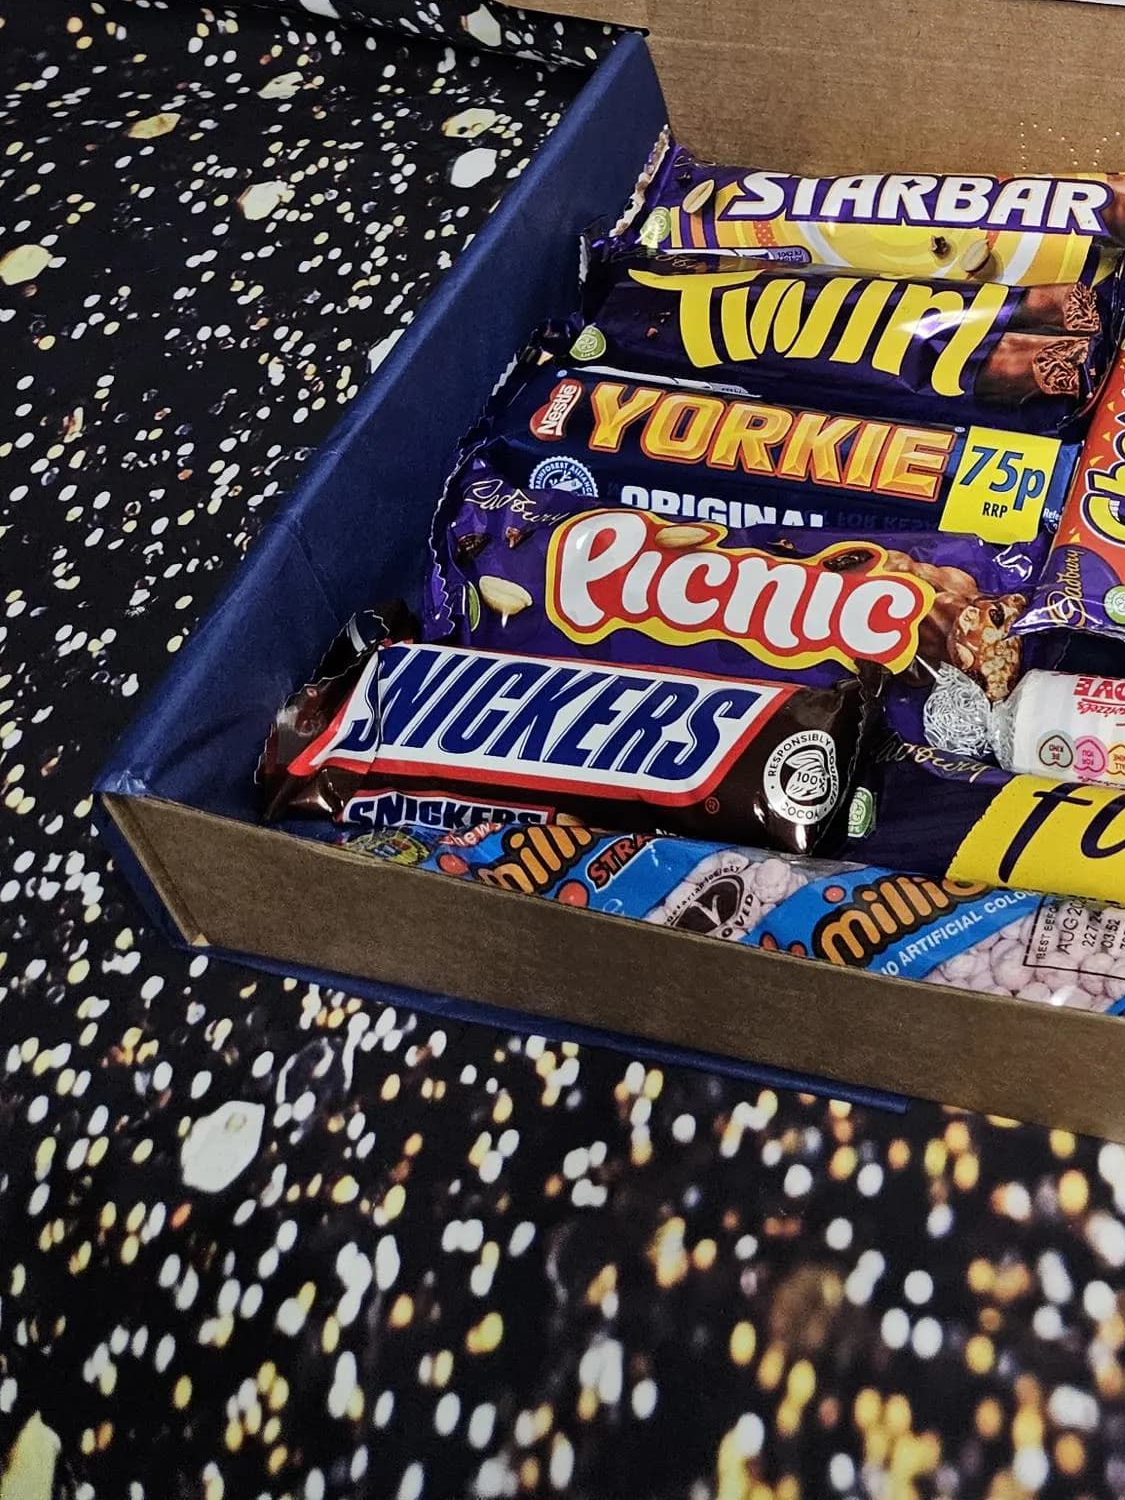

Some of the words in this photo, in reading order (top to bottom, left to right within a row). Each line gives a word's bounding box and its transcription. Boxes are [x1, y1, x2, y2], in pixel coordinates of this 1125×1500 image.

[589, 381, 956, 501] YORKIE
[959, 444, 1048, 513] 75p
[463, 479, 570, 526] Cadbury
[982, 500, 1008, 518] RRP
[556, 512, 916, 655] Picnic
[350, 645, 763, 781] SNICKERS
[768, 733, 831, 777] RESPONSIBLY
[875, 731, 990, 783] adbury
[349, 793, 542, 829] SNICKERS
[780, 801, 820, 820] COCOA
[722, 894, 754, 937] OVED
[1035, 933, 1049, 960] BEST
[1044, 902, 1060, 932] BEFO
[1056, 917, 1079, 956] AUG
[1081, 924, 1099, 948] 227
[898, 913, 984, 966] ARTIFICIAL
